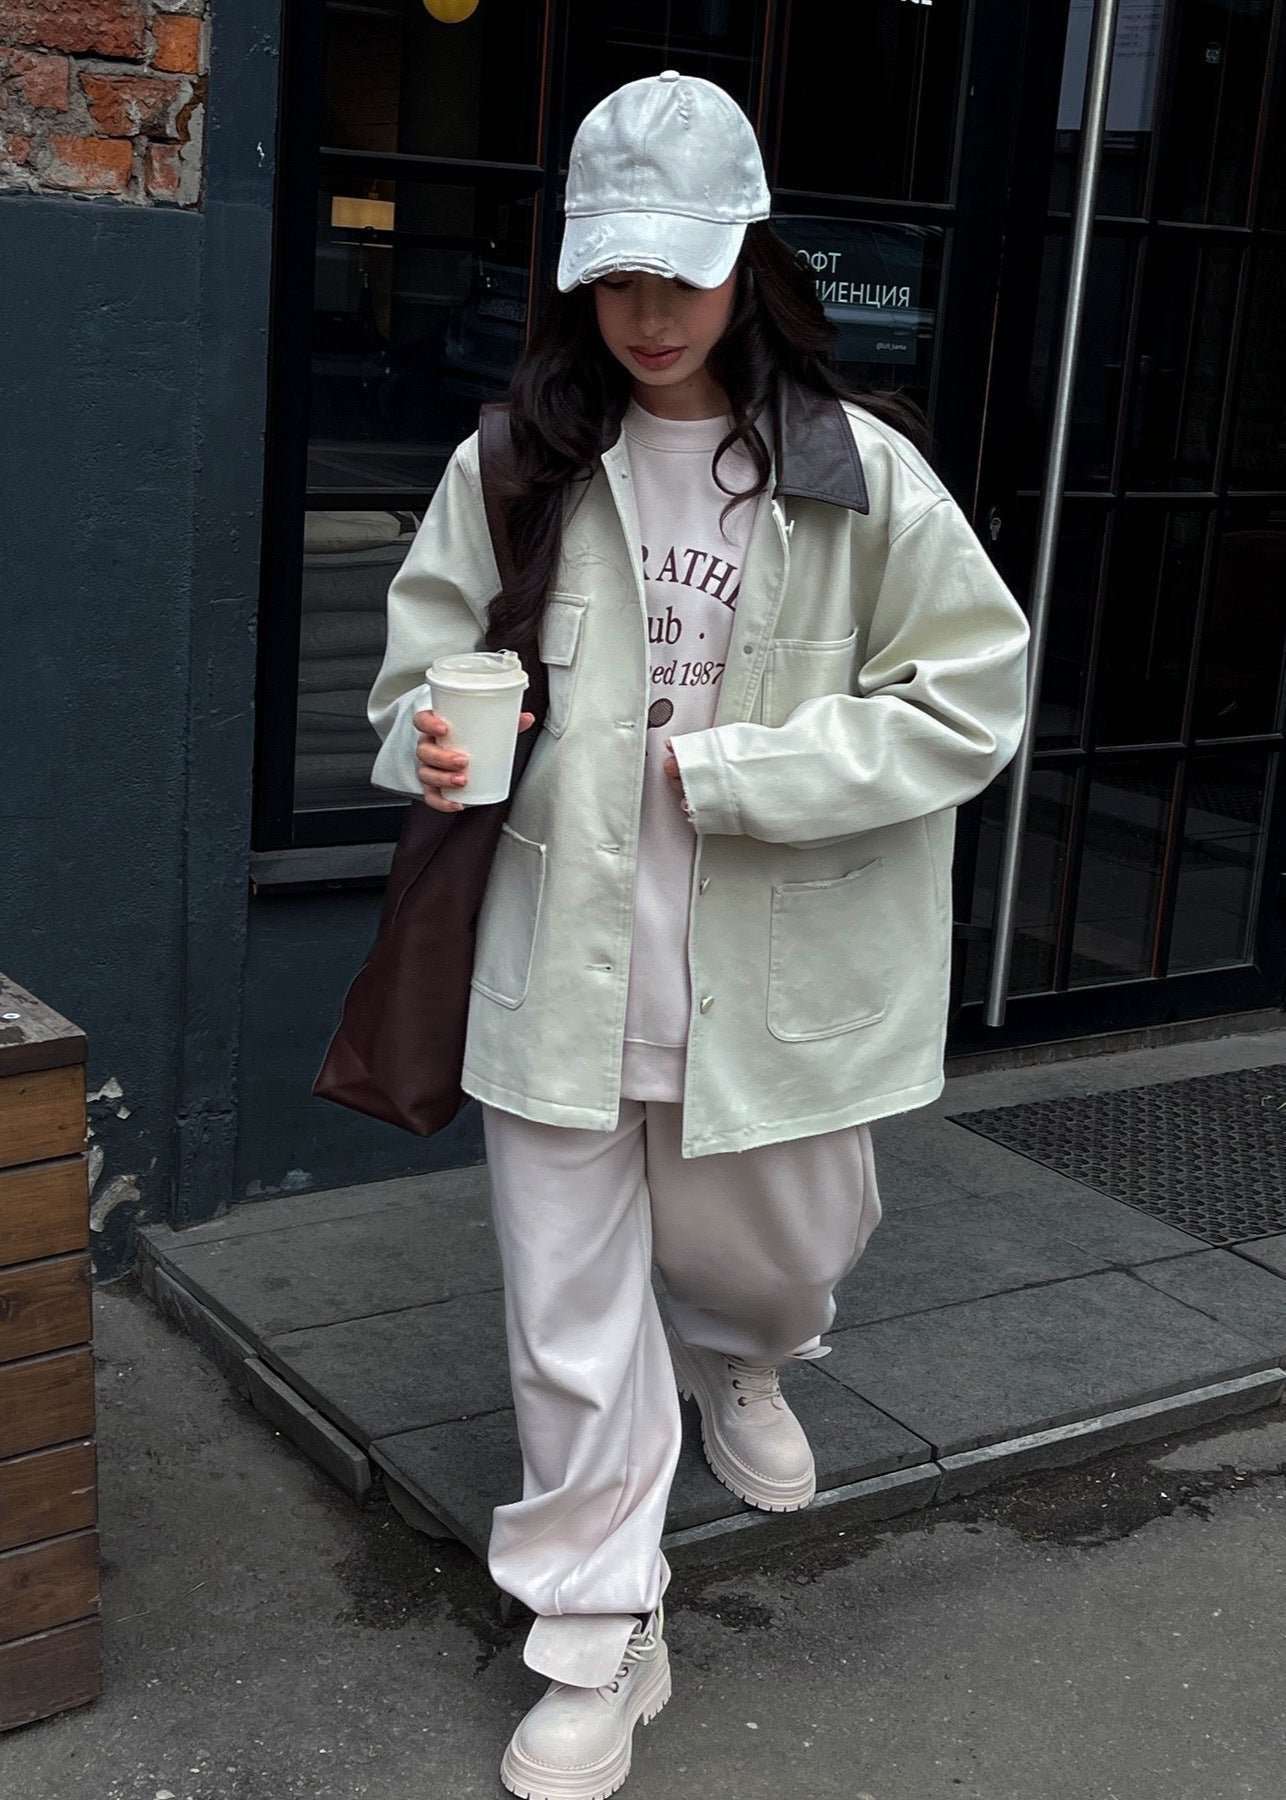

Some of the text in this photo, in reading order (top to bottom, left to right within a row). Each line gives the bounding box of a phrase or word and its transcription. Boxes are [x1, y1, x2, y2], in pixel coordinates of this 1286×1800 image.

[815, 280, 911, 309] ИЕНЦИЯ
[647, 605, 683, 645] ub
[649, 659, 725, 687] ed 1987
